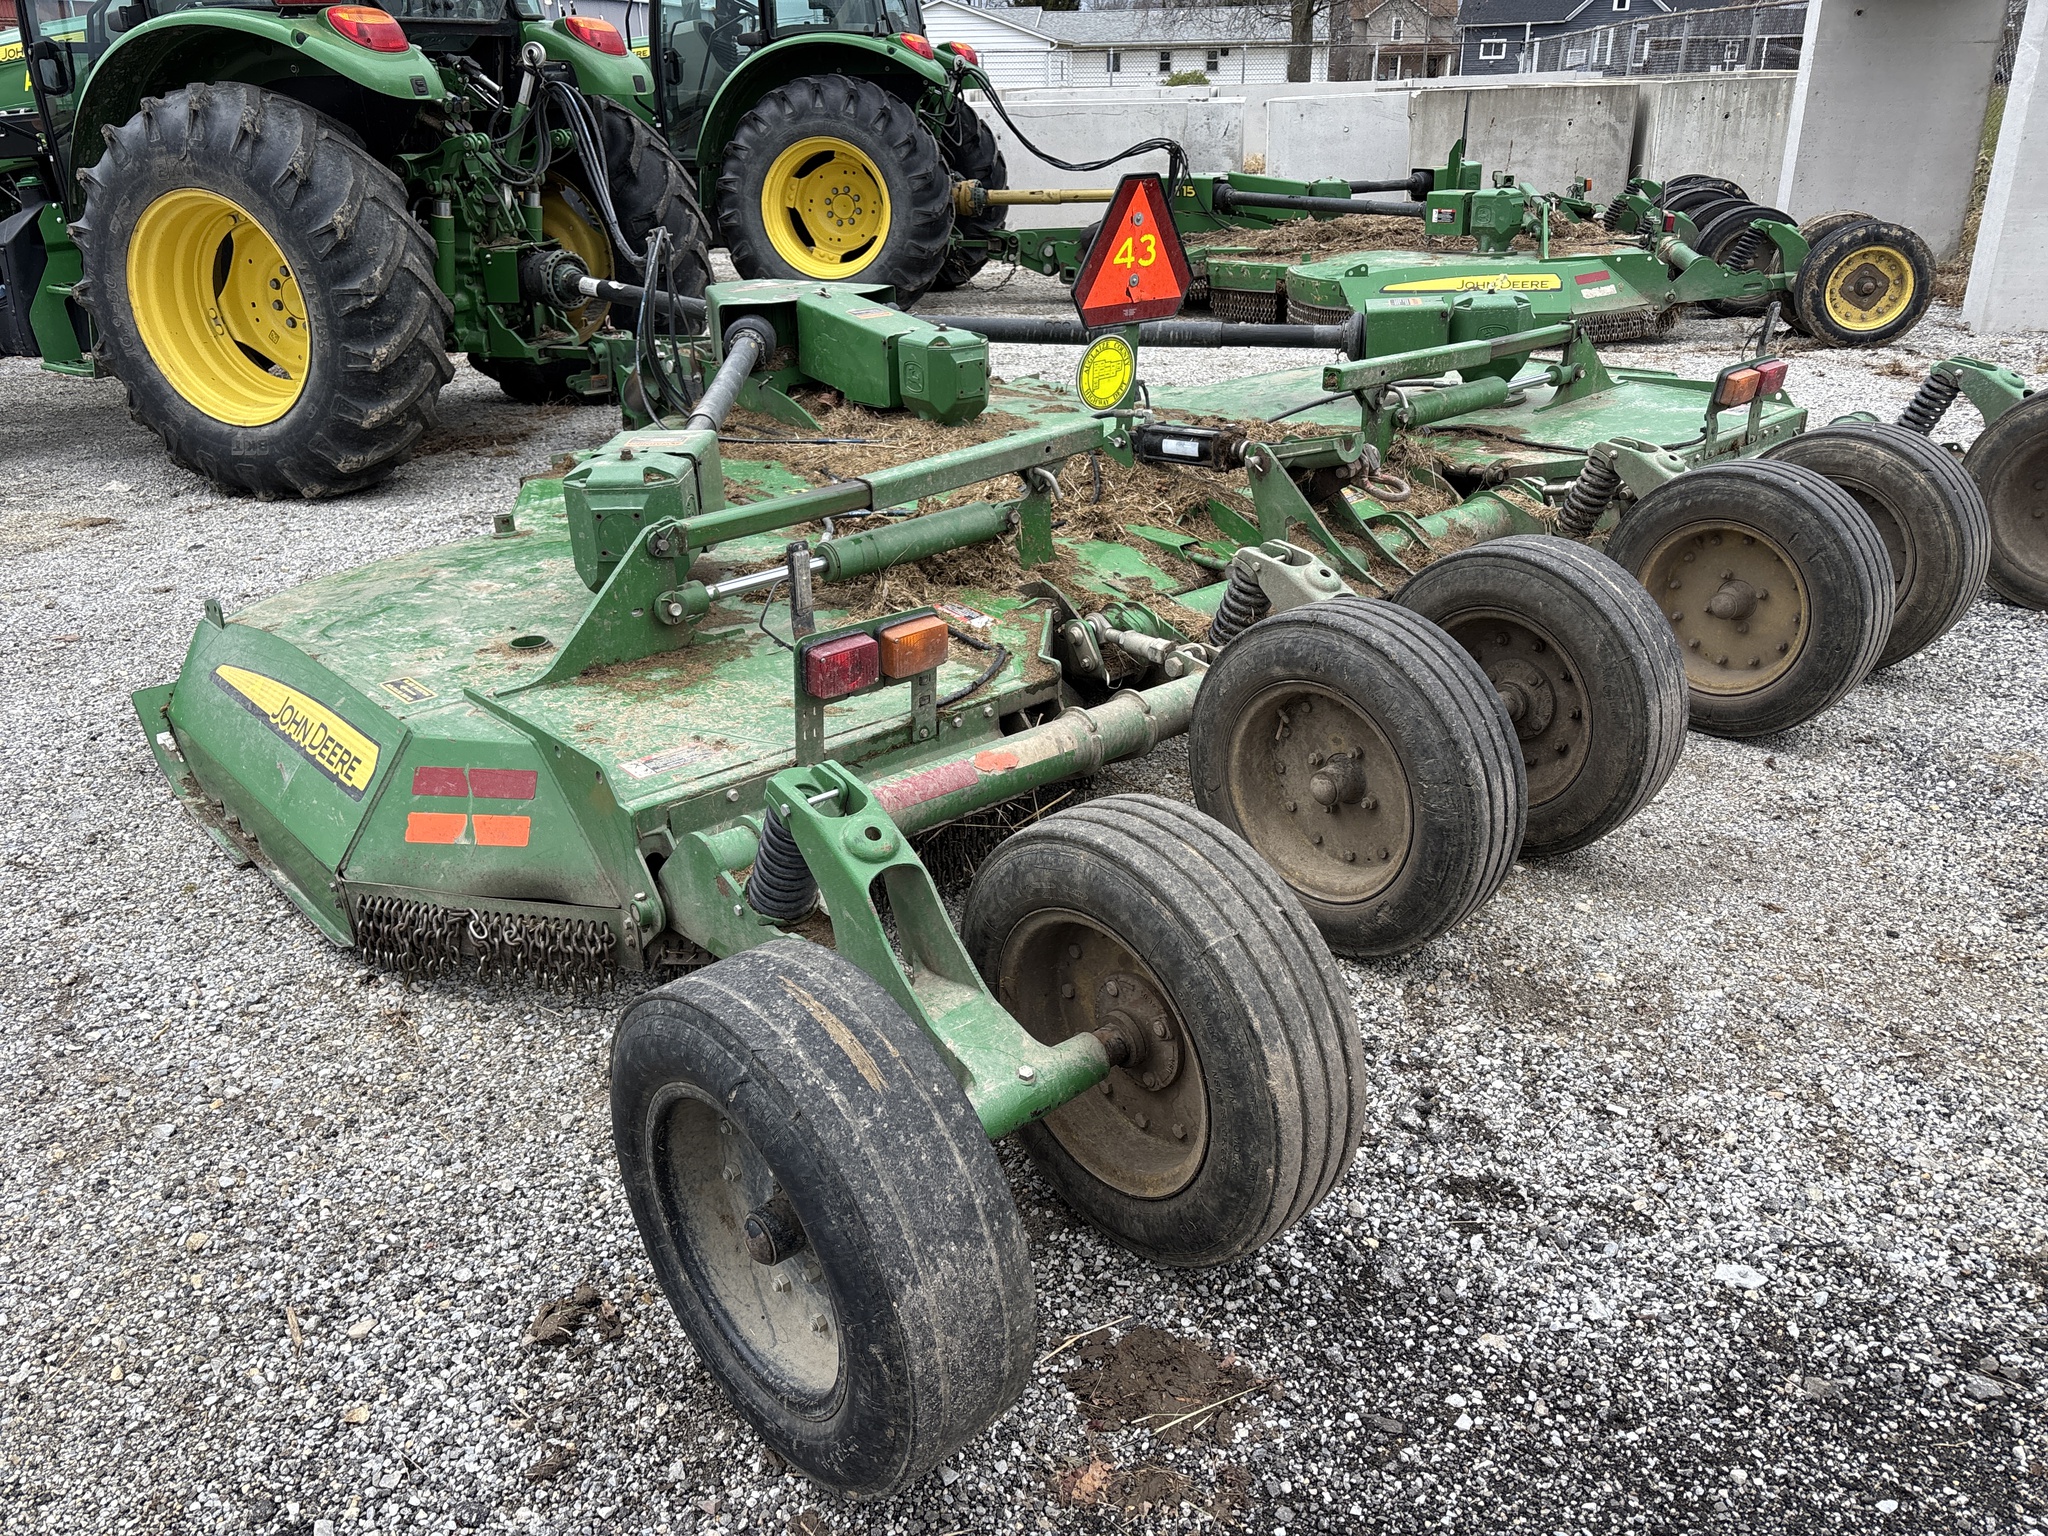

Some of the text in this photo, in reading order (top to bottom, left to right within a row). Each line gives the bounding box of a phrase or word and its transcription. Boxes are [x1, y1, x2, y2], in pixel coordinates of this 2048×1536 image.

[1, 46, 24, 60] JOH
[1113, 233, 1157, 269] 43
[1500, 279, 1549, 289] DEERE
[1084, 341, 1131, 375] AUGLAIZE COUNTY
[1085, 388, 1109, 406] HIGHWAY
[271, 696, 362, 782] JOHN DEERE
